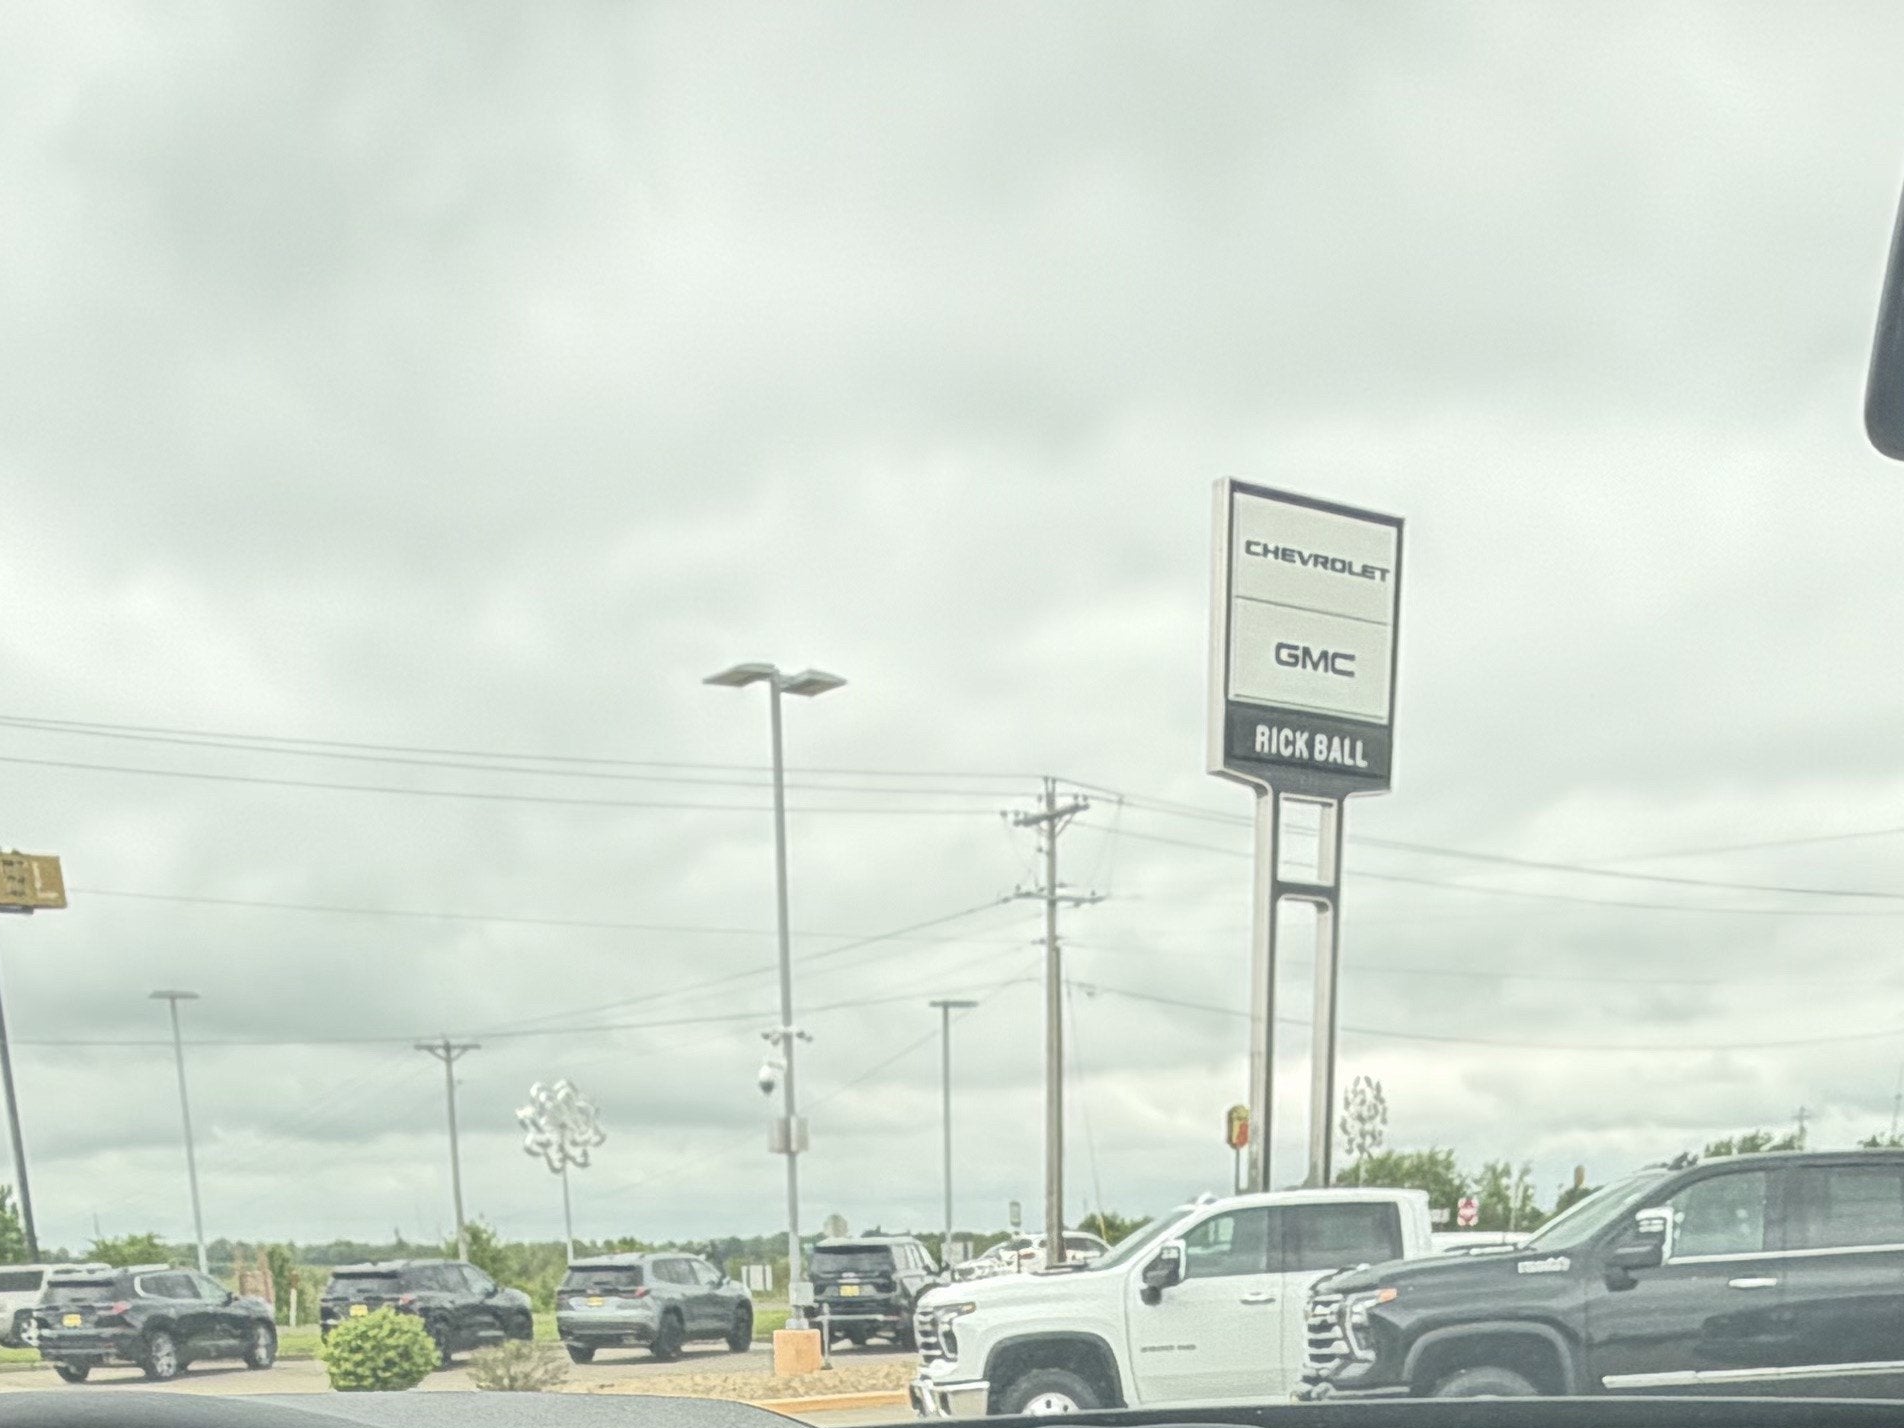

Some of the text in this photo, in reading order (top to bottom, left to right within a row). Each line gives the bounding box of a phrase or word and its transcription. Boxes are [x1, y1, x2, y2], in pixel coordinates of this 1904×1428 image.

[1245, 539, 1390, 583] CHEVROLET
[1275, 641, 1356, 678] GMC
[1255, 724, 1368, 768] RICK BALL
